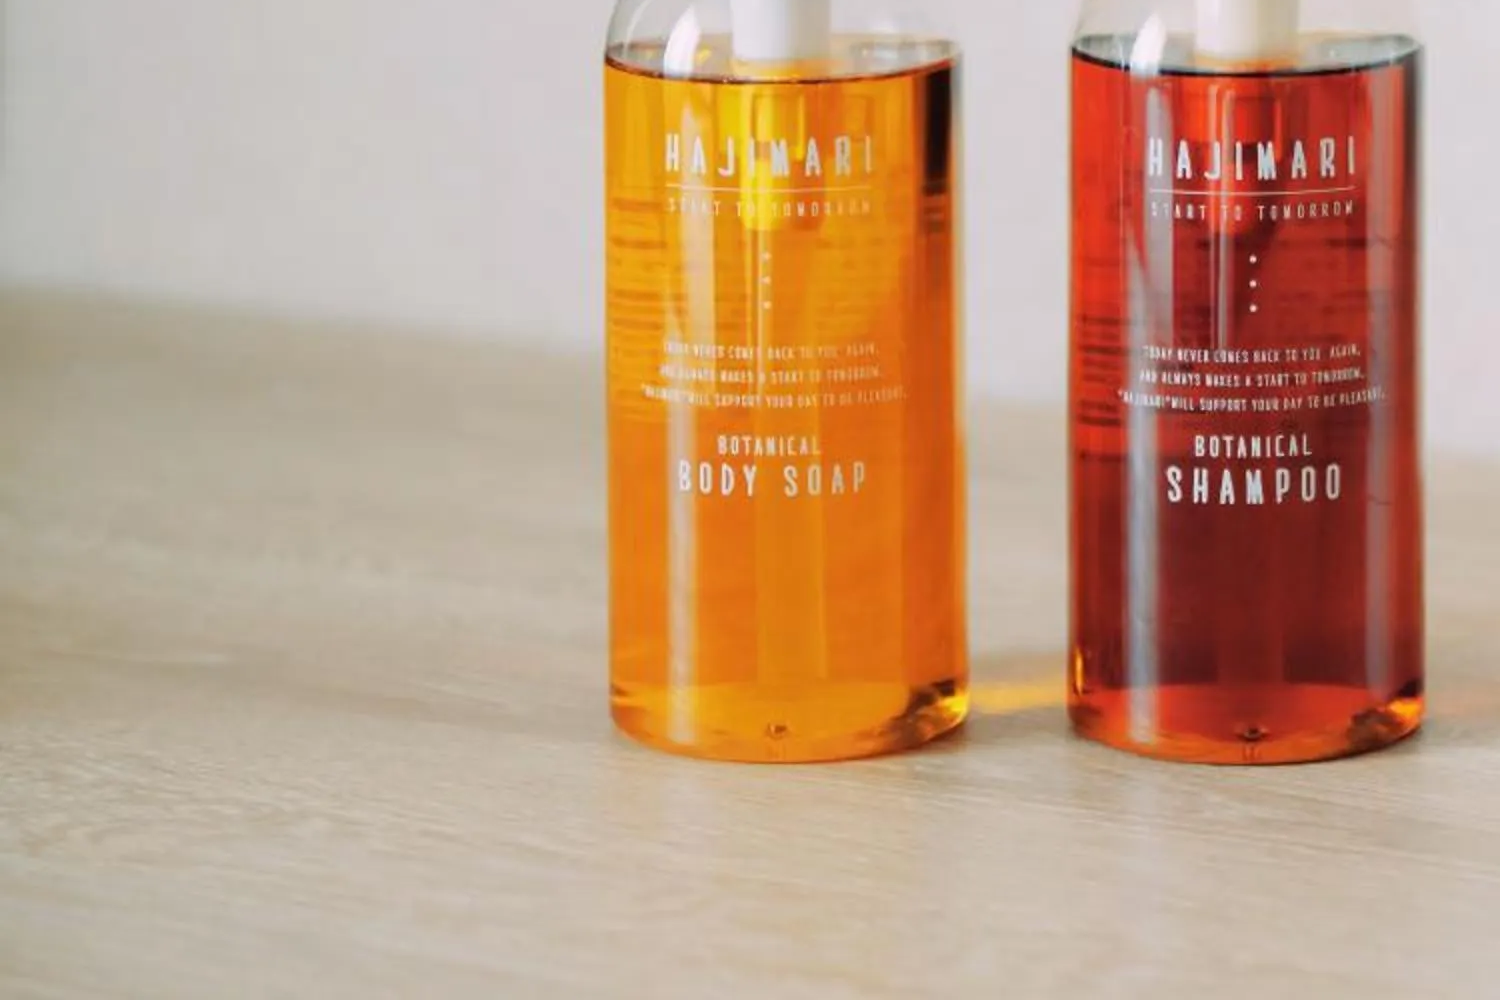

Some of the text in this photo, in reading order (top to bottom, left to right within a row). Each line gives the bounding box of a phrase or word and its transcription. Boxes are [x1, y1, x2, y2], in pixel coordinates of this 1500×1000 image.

[666, 133, 872, 177] HAJIMARI
[1149, 136, 1355, 180] HAJIMARI
[1258, 200, 1354, 221] TOMORROW
[717, 435, 821, 458] BOTANICAL
[1195, 434, 1312, 459] BOTANICAL
[679, 459, 865, 497] BODY SOAP
[1166, 462, 1341, 505] SHAMPOO
